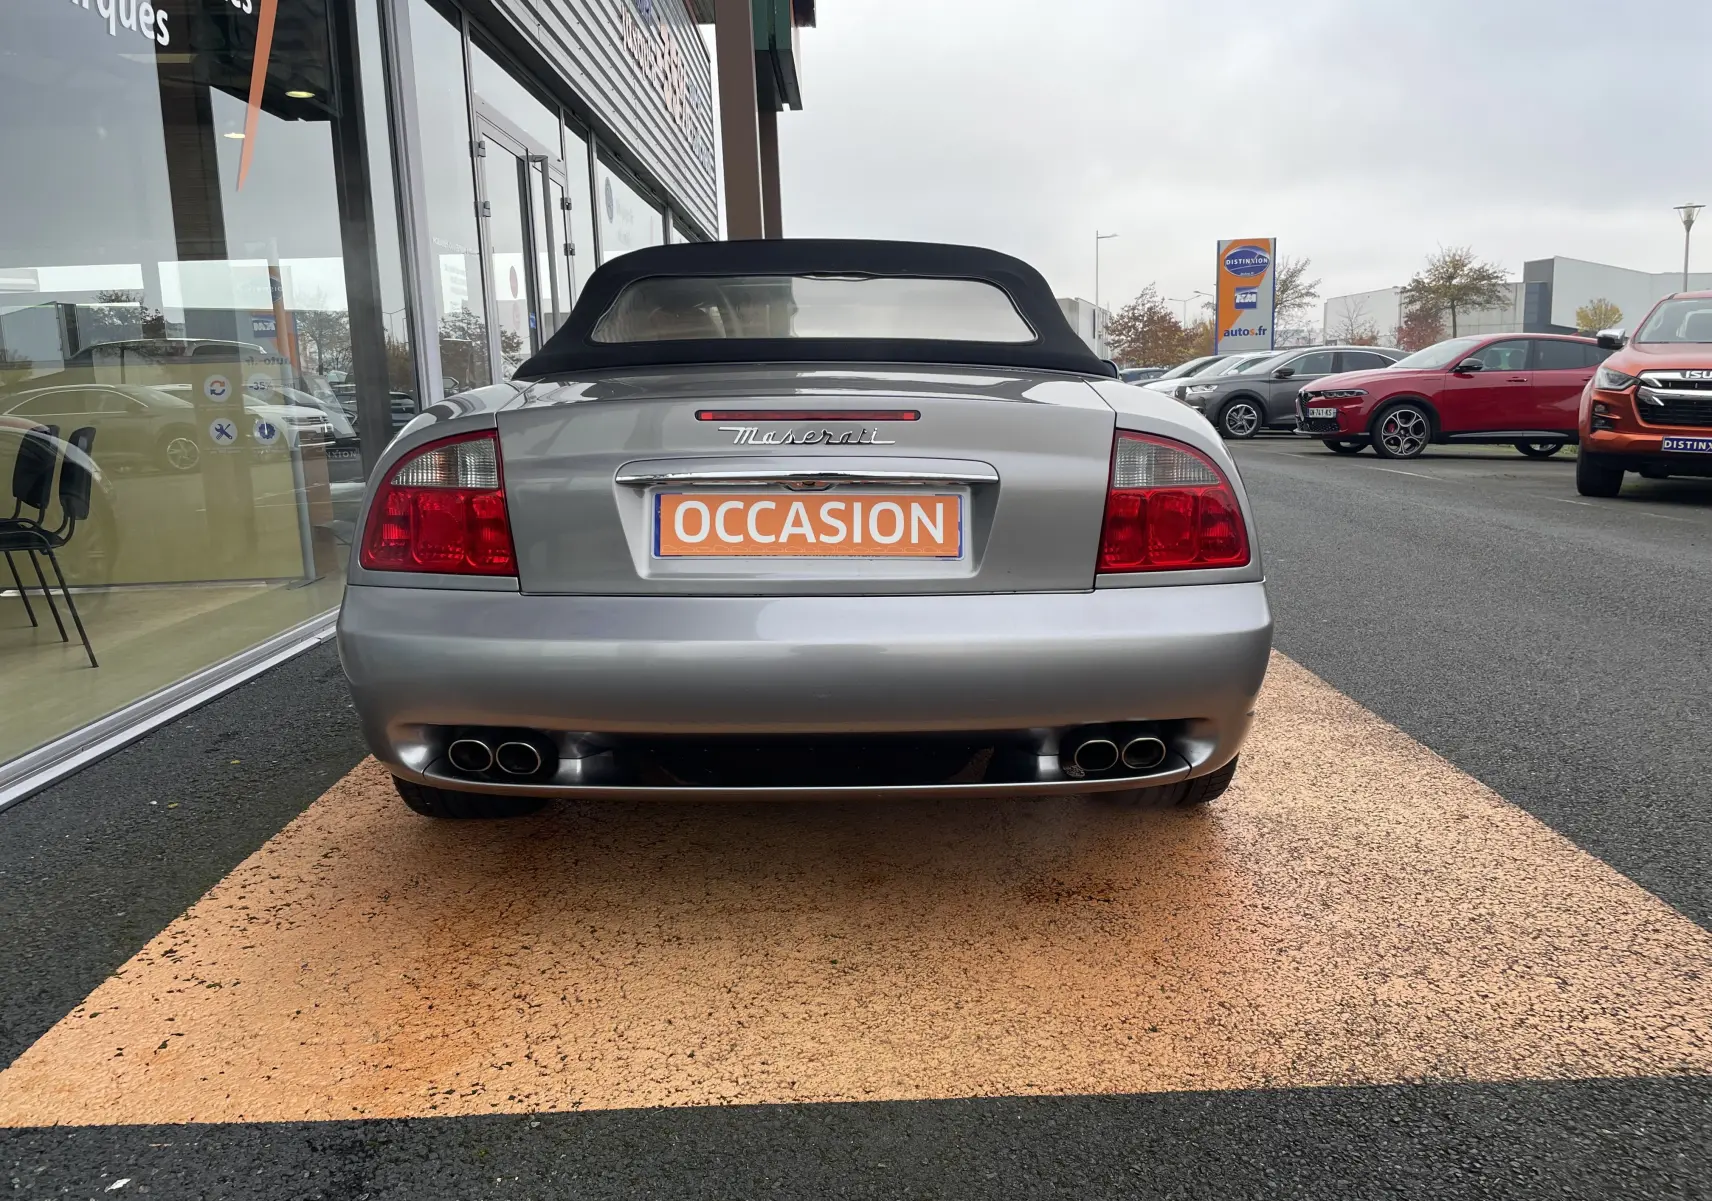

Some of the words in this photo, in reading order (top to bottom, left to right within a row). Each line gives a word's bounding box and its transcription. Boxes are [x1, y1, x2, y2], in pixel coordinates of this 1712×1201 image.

[1226, 257, 1268, 266] DISTINXION
[1223, 325, 1267, 337] autos.fr
[718, 426, 896, 445] Maserati
[673, 500, 944, 544] OCCASION
